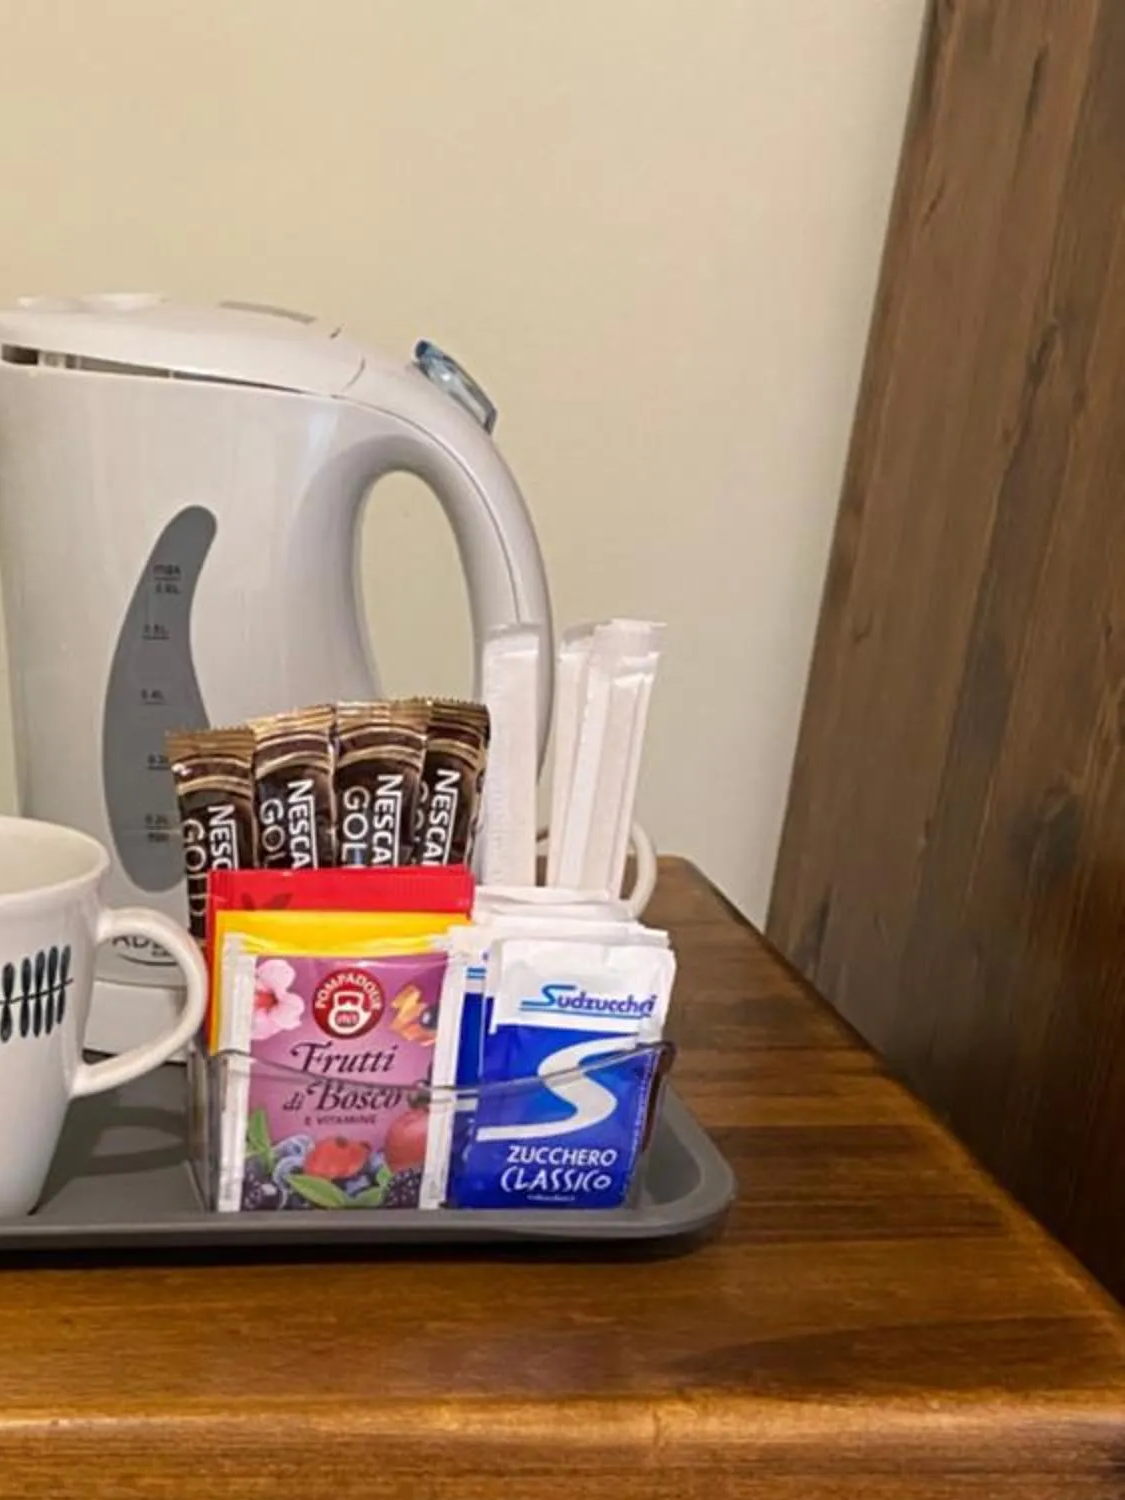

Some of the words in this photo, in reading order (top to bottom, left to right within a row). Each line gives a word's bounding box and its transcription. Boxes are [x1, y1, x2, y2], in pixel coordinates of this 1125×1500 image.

[290, 1041, 399, 1073] Frutti
[282, 1091, 304, 1111] di
[306, 1078, 401, 1111] Bosco
[507, 1145, 617, 1167] ZUCCHERO
[500, 1165, 612, 1192] CLASSICO
